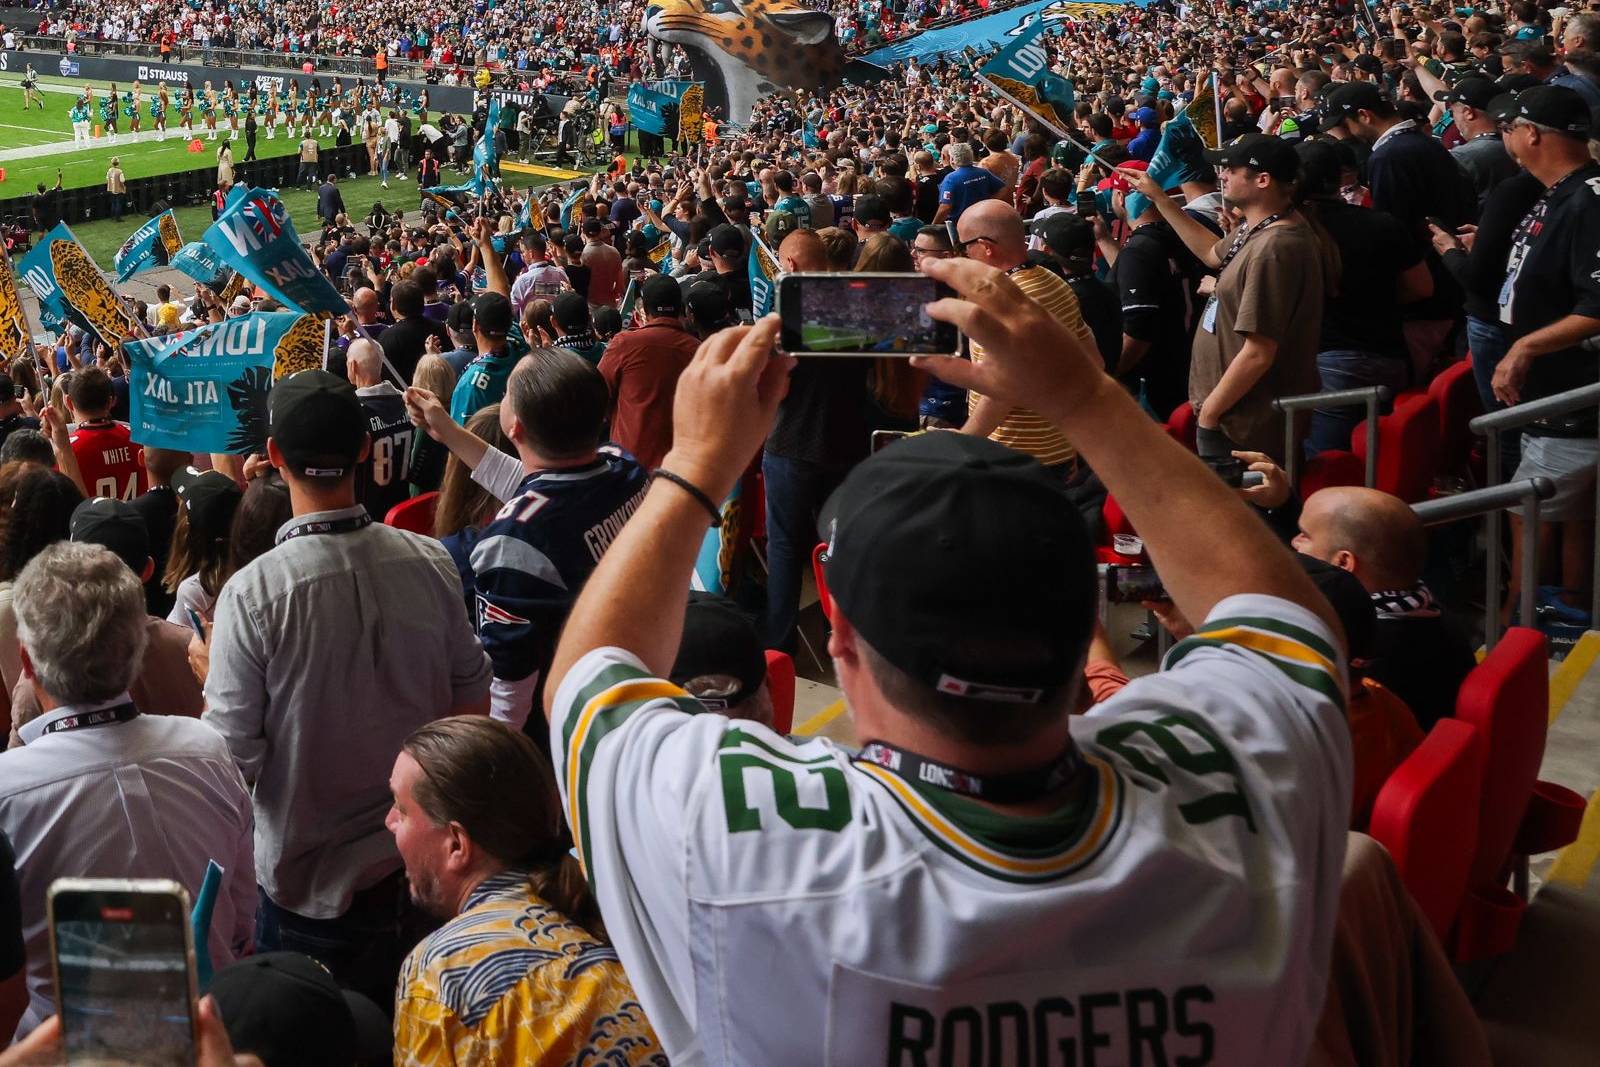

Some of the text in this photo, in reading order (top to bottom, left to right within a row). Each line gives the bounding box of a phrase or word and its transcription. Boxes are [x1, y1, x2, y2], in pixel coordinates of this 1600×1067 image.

[148, 67, 189, 82] STRAUSS
[469, 370, 490, 391] 16
[102, 446, 131, 466] WHITE
[373, 431, 413, 486] 87
[495, 490, 550, 524] 87
[55, 717, 79, 731] LONDON
[918, 760, 983, 794] LONDON
[889, 984, 1215, 1067] RODGERS
